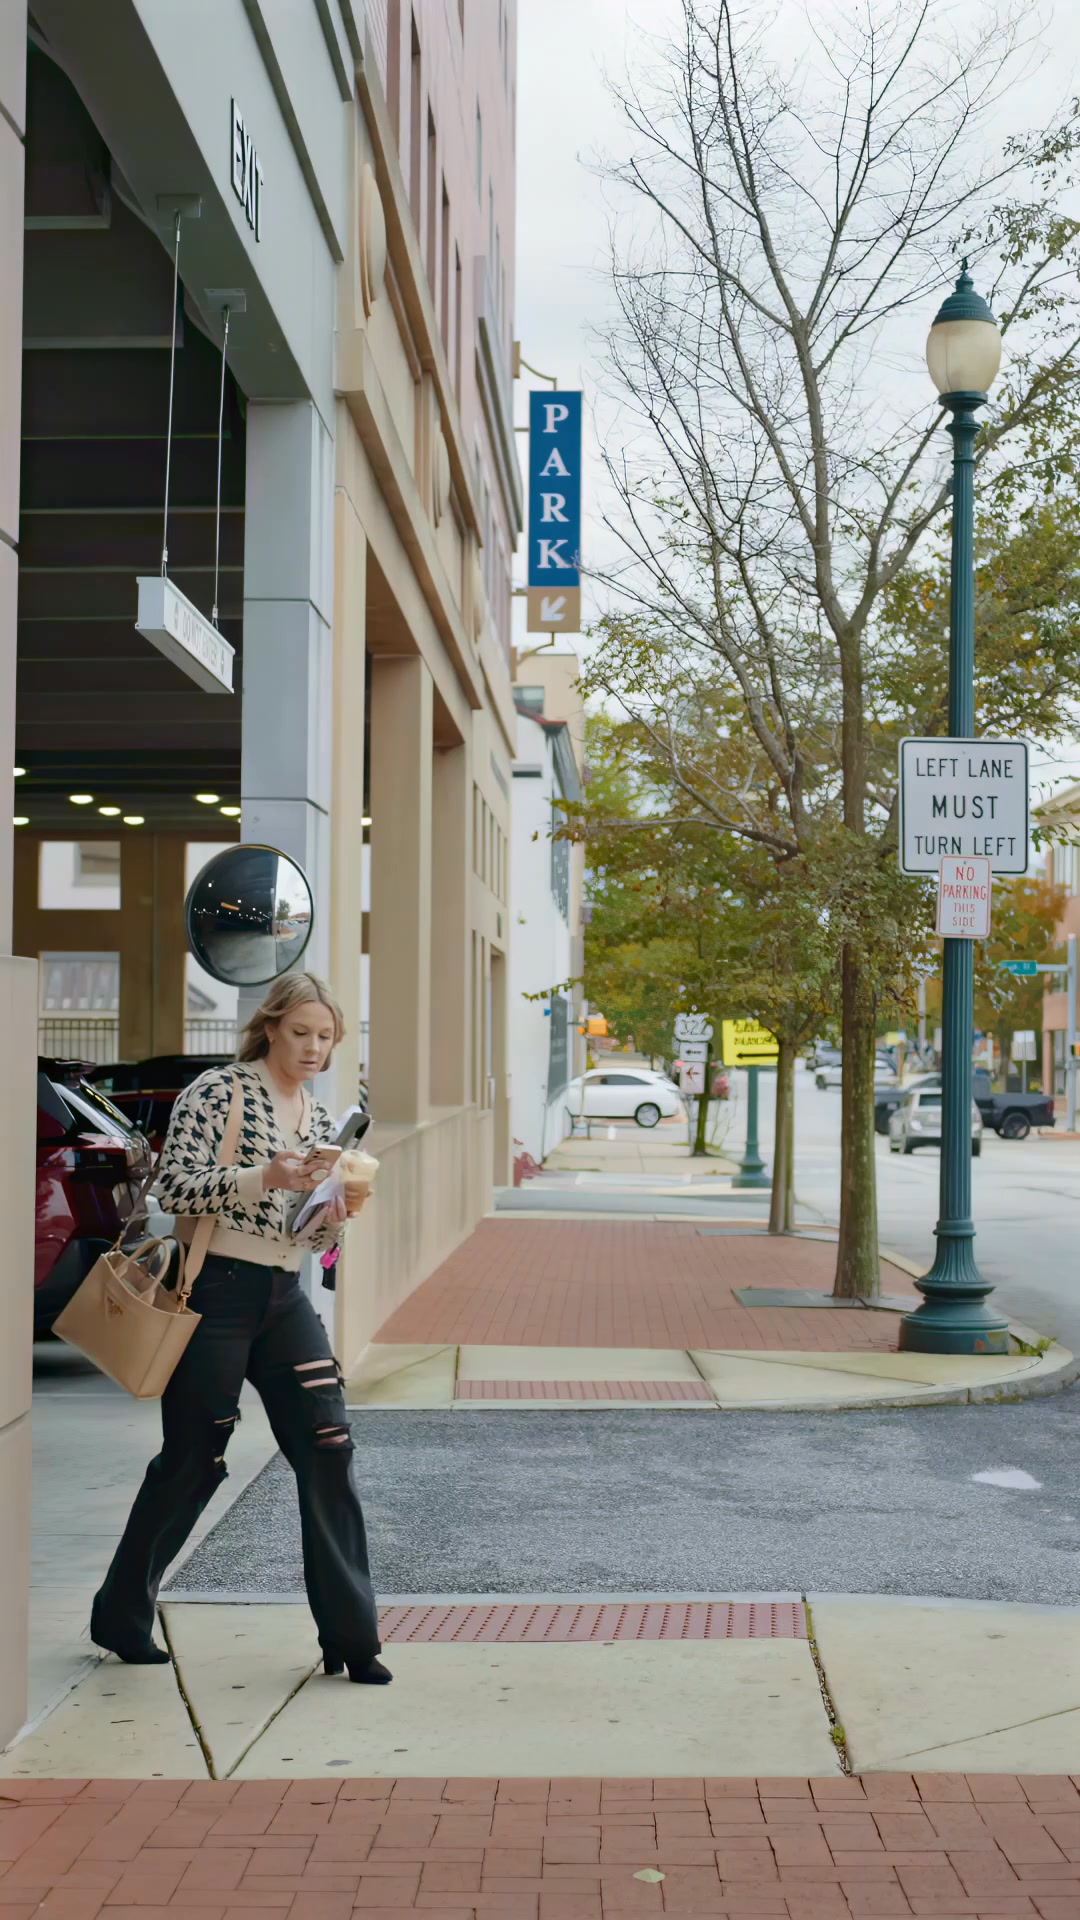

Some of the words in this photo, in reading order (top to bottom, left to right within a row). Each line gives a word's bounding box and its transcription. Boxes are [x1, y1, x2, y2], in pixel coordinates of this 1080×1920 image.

[230, 96, 264, 243] EXIT
[536, 403, 573, 569] PARK
[916, 757, 958, 777] LEFT
[968, 758, 1014, 778] LANE
[932, 795, 998, 819] MUST
[914, 836, 962, 855] TURN
[973, 836, 1016, 856] LEFT
[955, 866, 975, 881] NO
[943, 883, 987, 900] PARKING
[953, 902, 976, 913] THIS
[952, 916, 976, 927] SIDE
